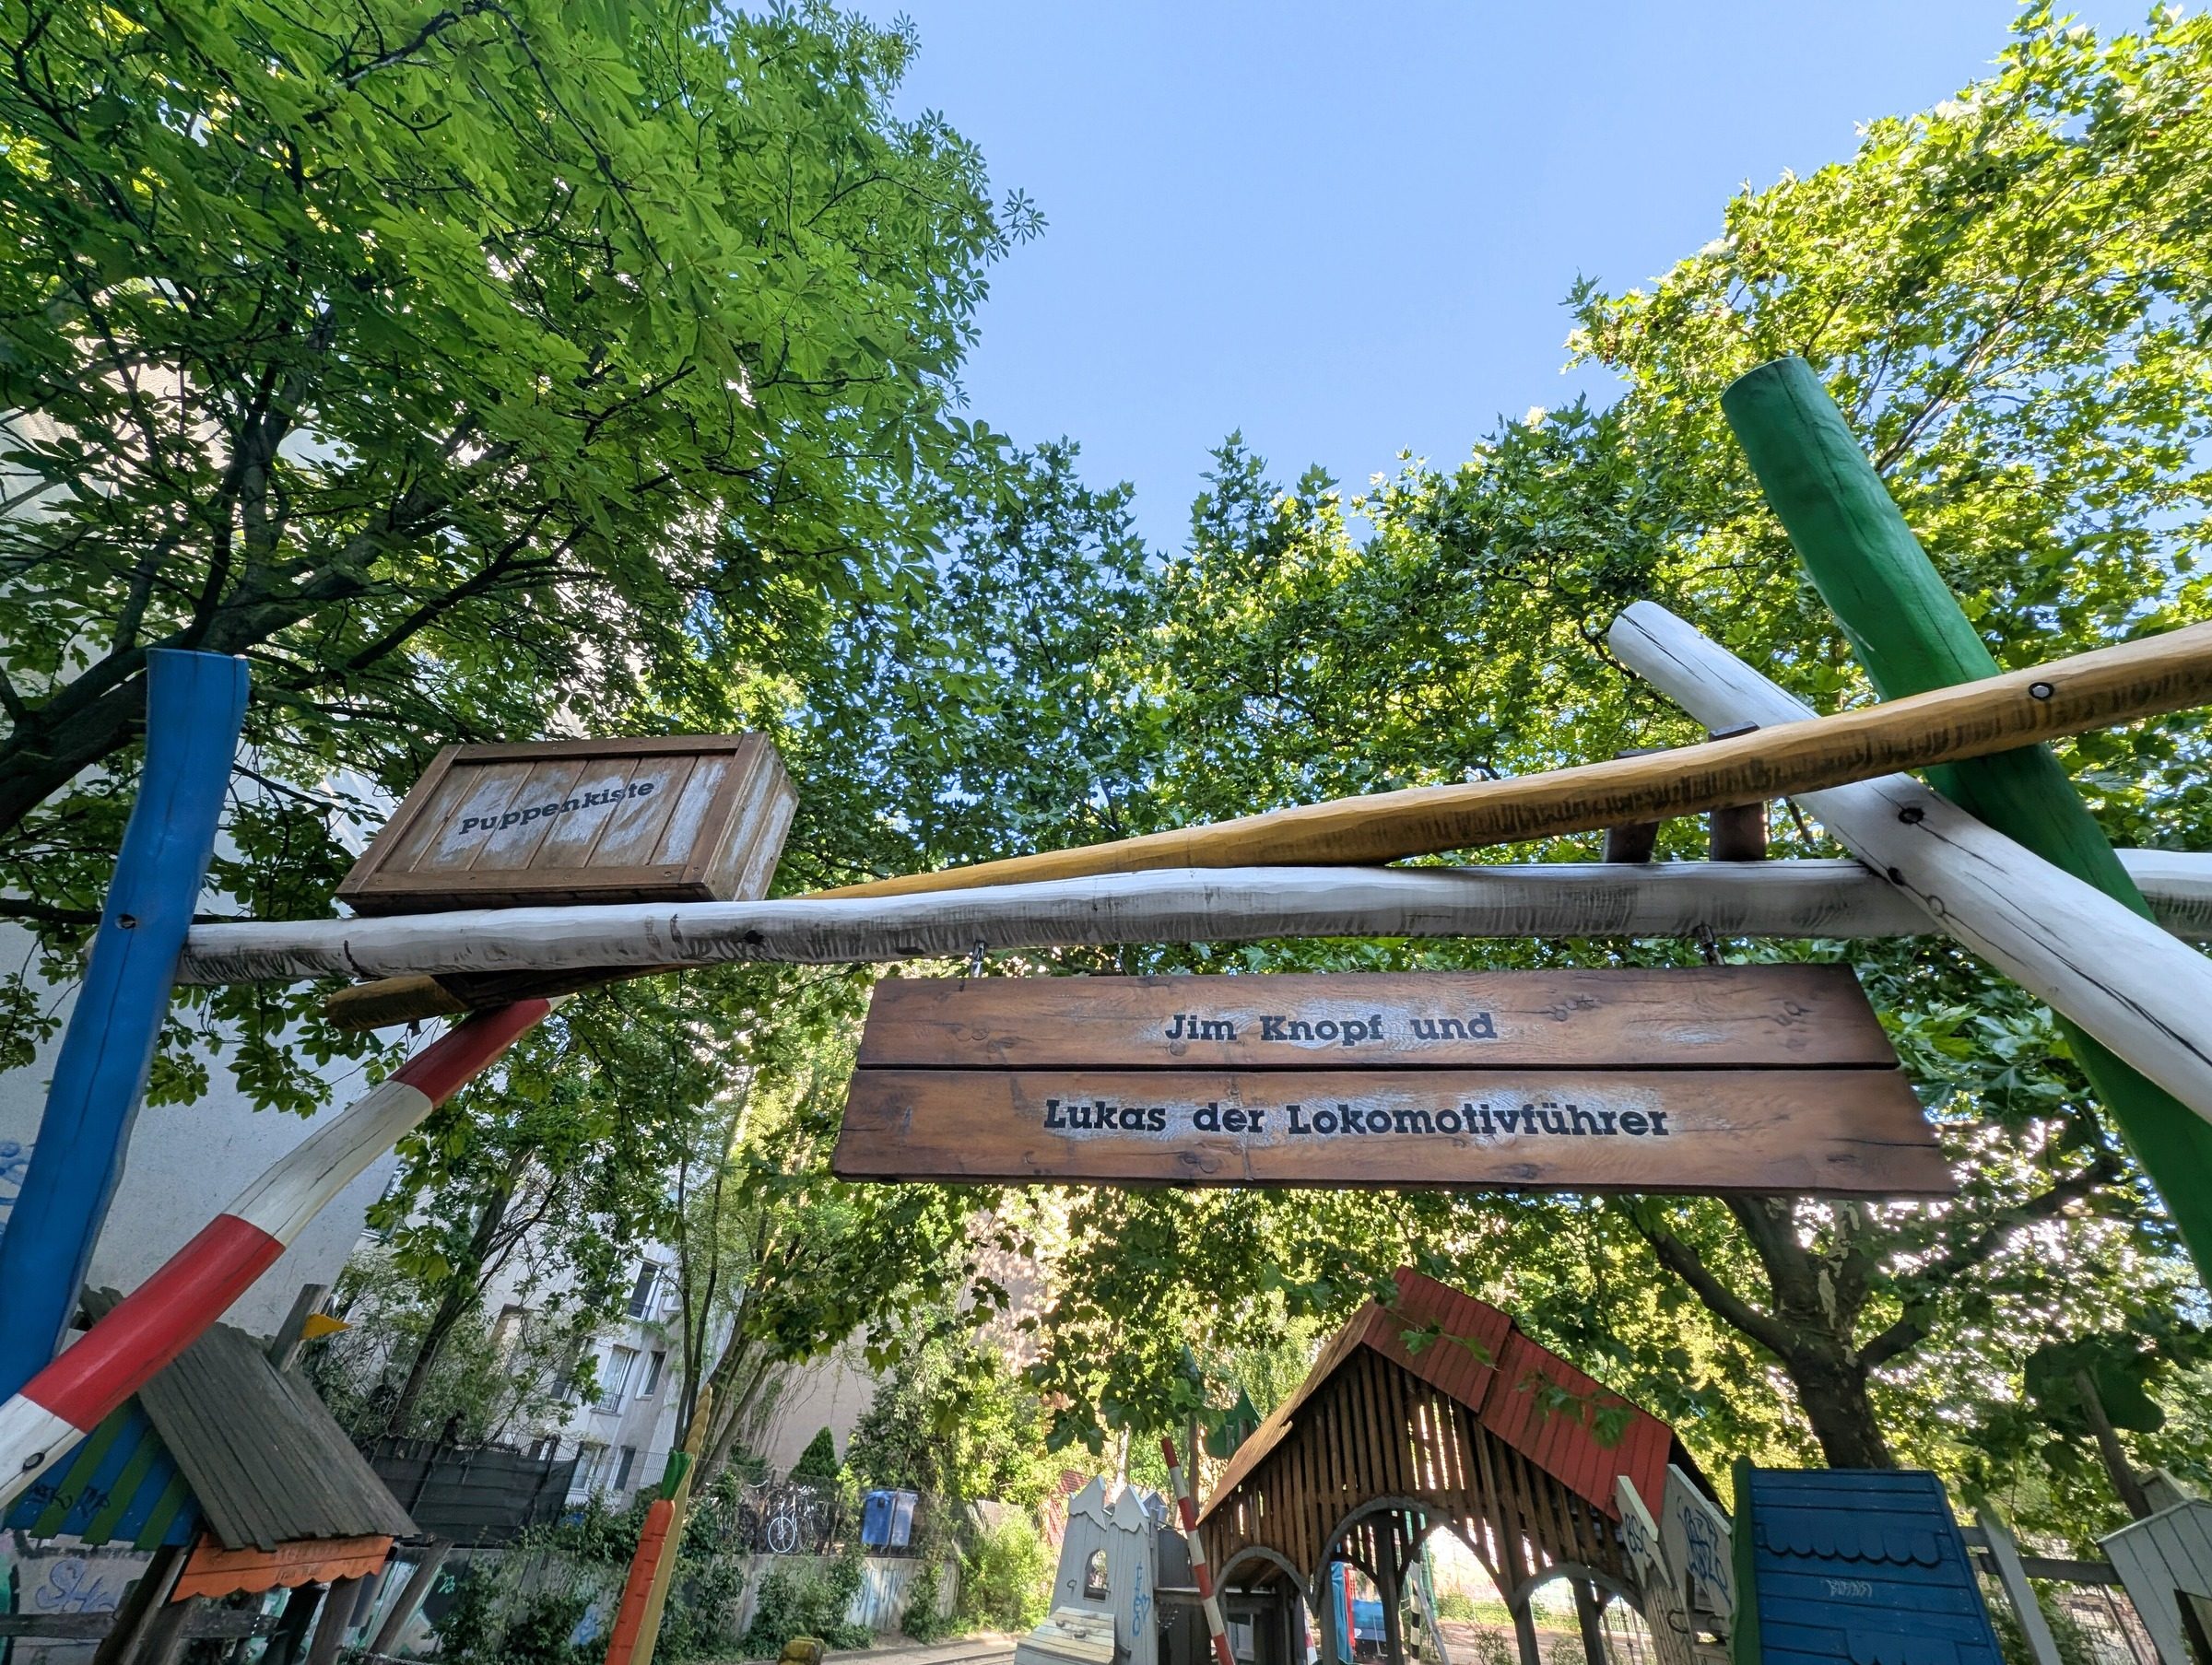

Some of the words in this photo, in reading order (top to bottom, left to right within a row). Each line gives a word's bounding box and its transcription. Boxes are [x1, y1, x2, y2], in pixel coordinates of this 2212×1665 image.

[458, 781, 655, 835] Puppenkiste
[1165, 1014, 1237, 1040] Jim
[1259, 1014, 1383, 1047] Knopf
[1409, 1012, 1499, 1040] und
[1043, 1099, 1167, 1132] Lukas
[1193, 1102, 1265, 1133] der
[1286, 1102, 1670, 1136] Lokomotivführer
